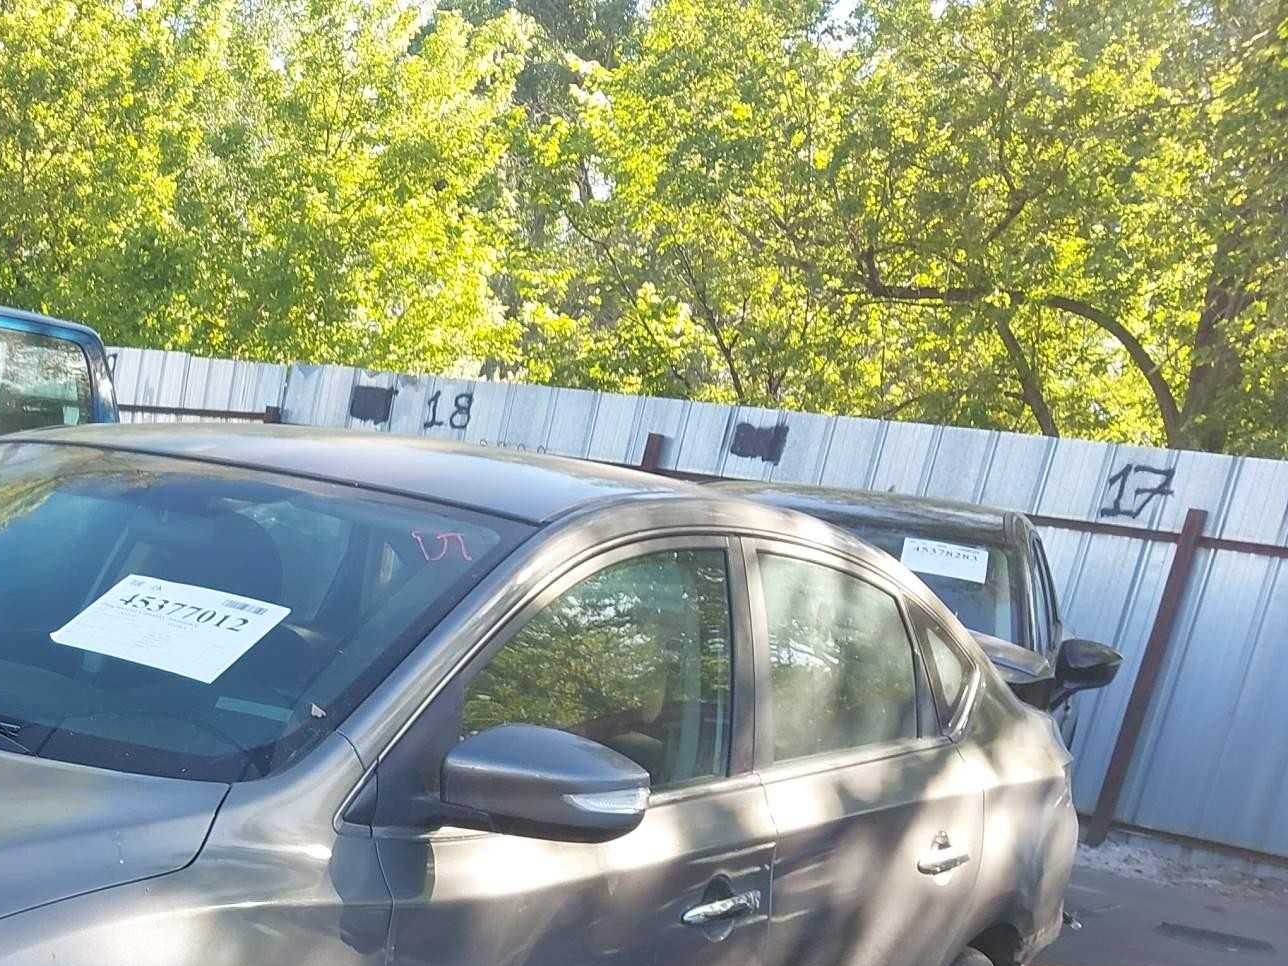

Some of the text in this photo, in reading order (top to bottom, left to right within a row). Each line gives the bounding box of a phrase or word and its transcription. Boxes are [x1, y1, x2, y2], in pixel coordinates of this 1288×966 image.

[423, 389, 474, 429] 18
[1100, 463, 1175, 519] 17
[119, 593, 250, 632] 45377012
